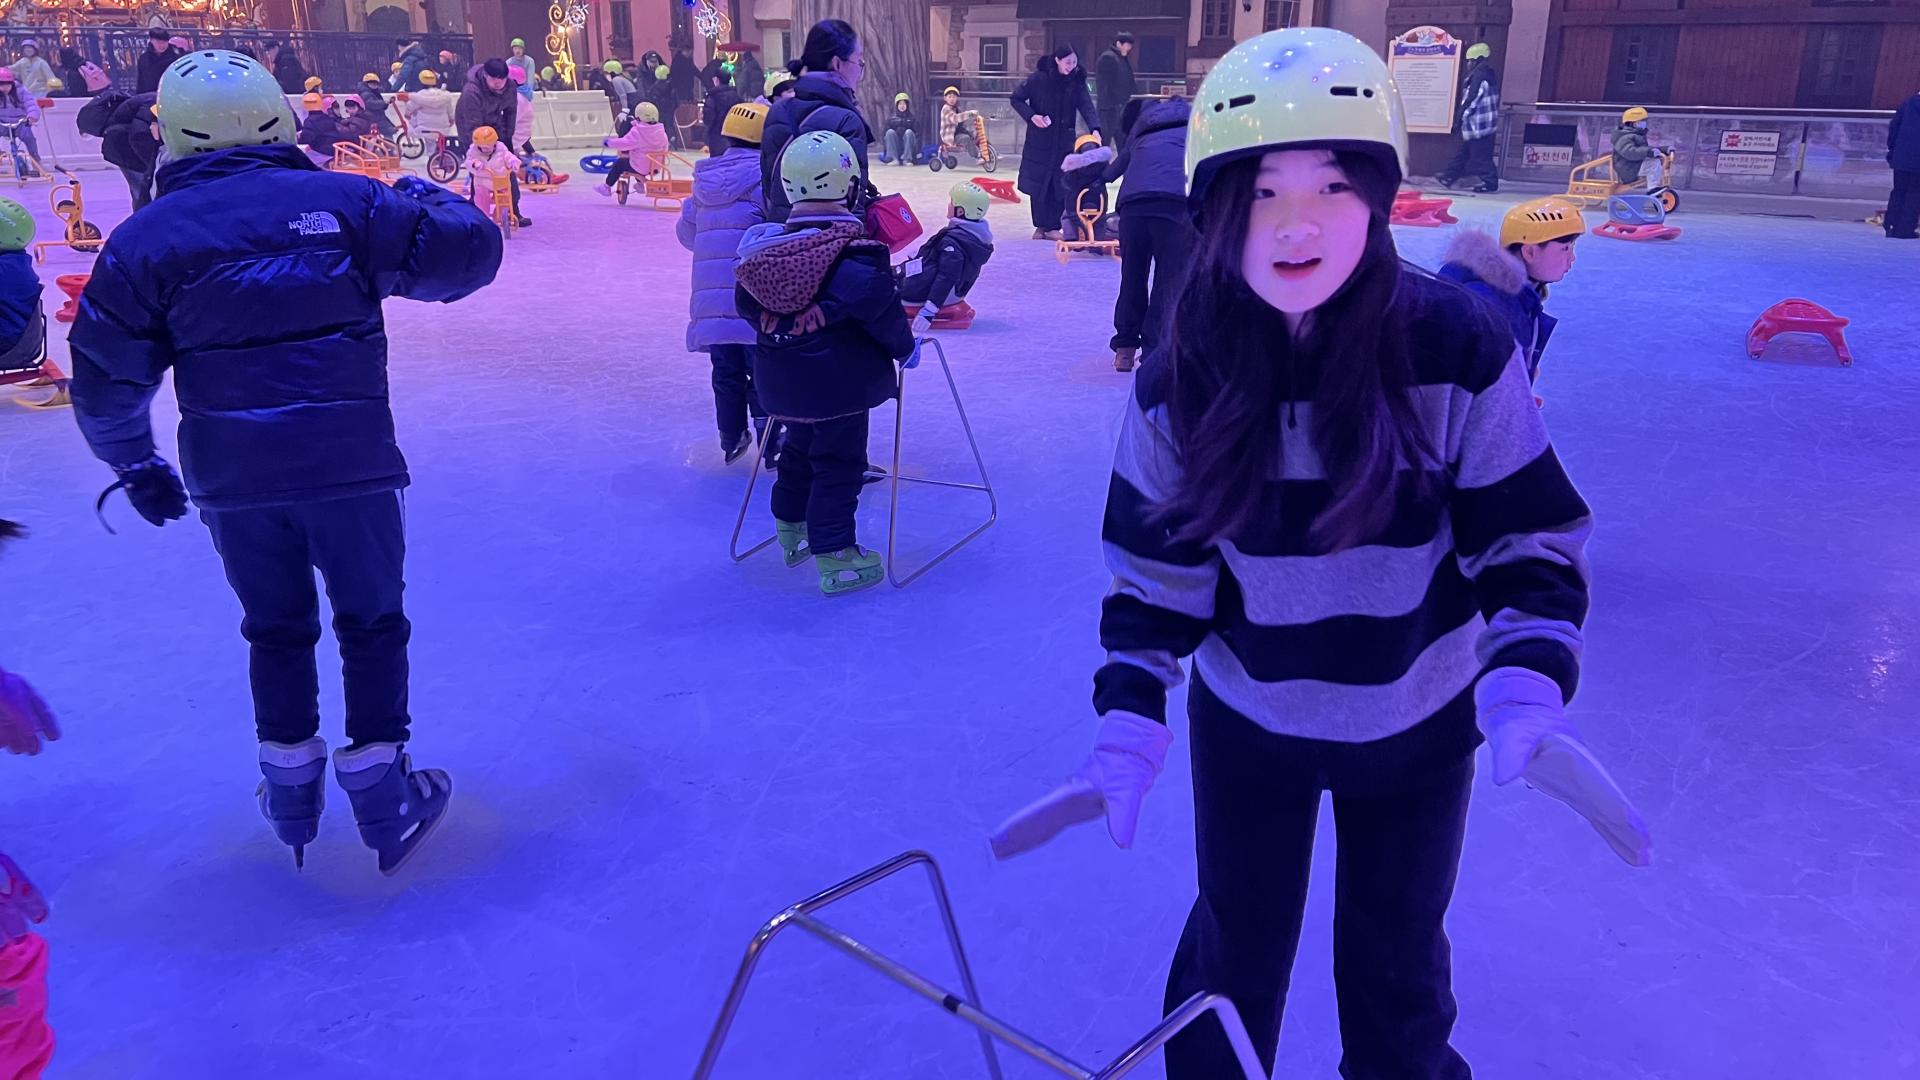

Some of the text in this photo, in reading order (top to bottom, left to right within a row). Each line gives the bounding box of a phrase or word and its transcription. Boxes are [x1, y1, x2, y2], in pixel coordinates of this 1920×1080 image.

[1542, 151, 1570, 162] 천천히
[300, 211, 321, 221] THE
[288, 219, 322, 230] NORTH
[300, 226, 324, 236] FACE
